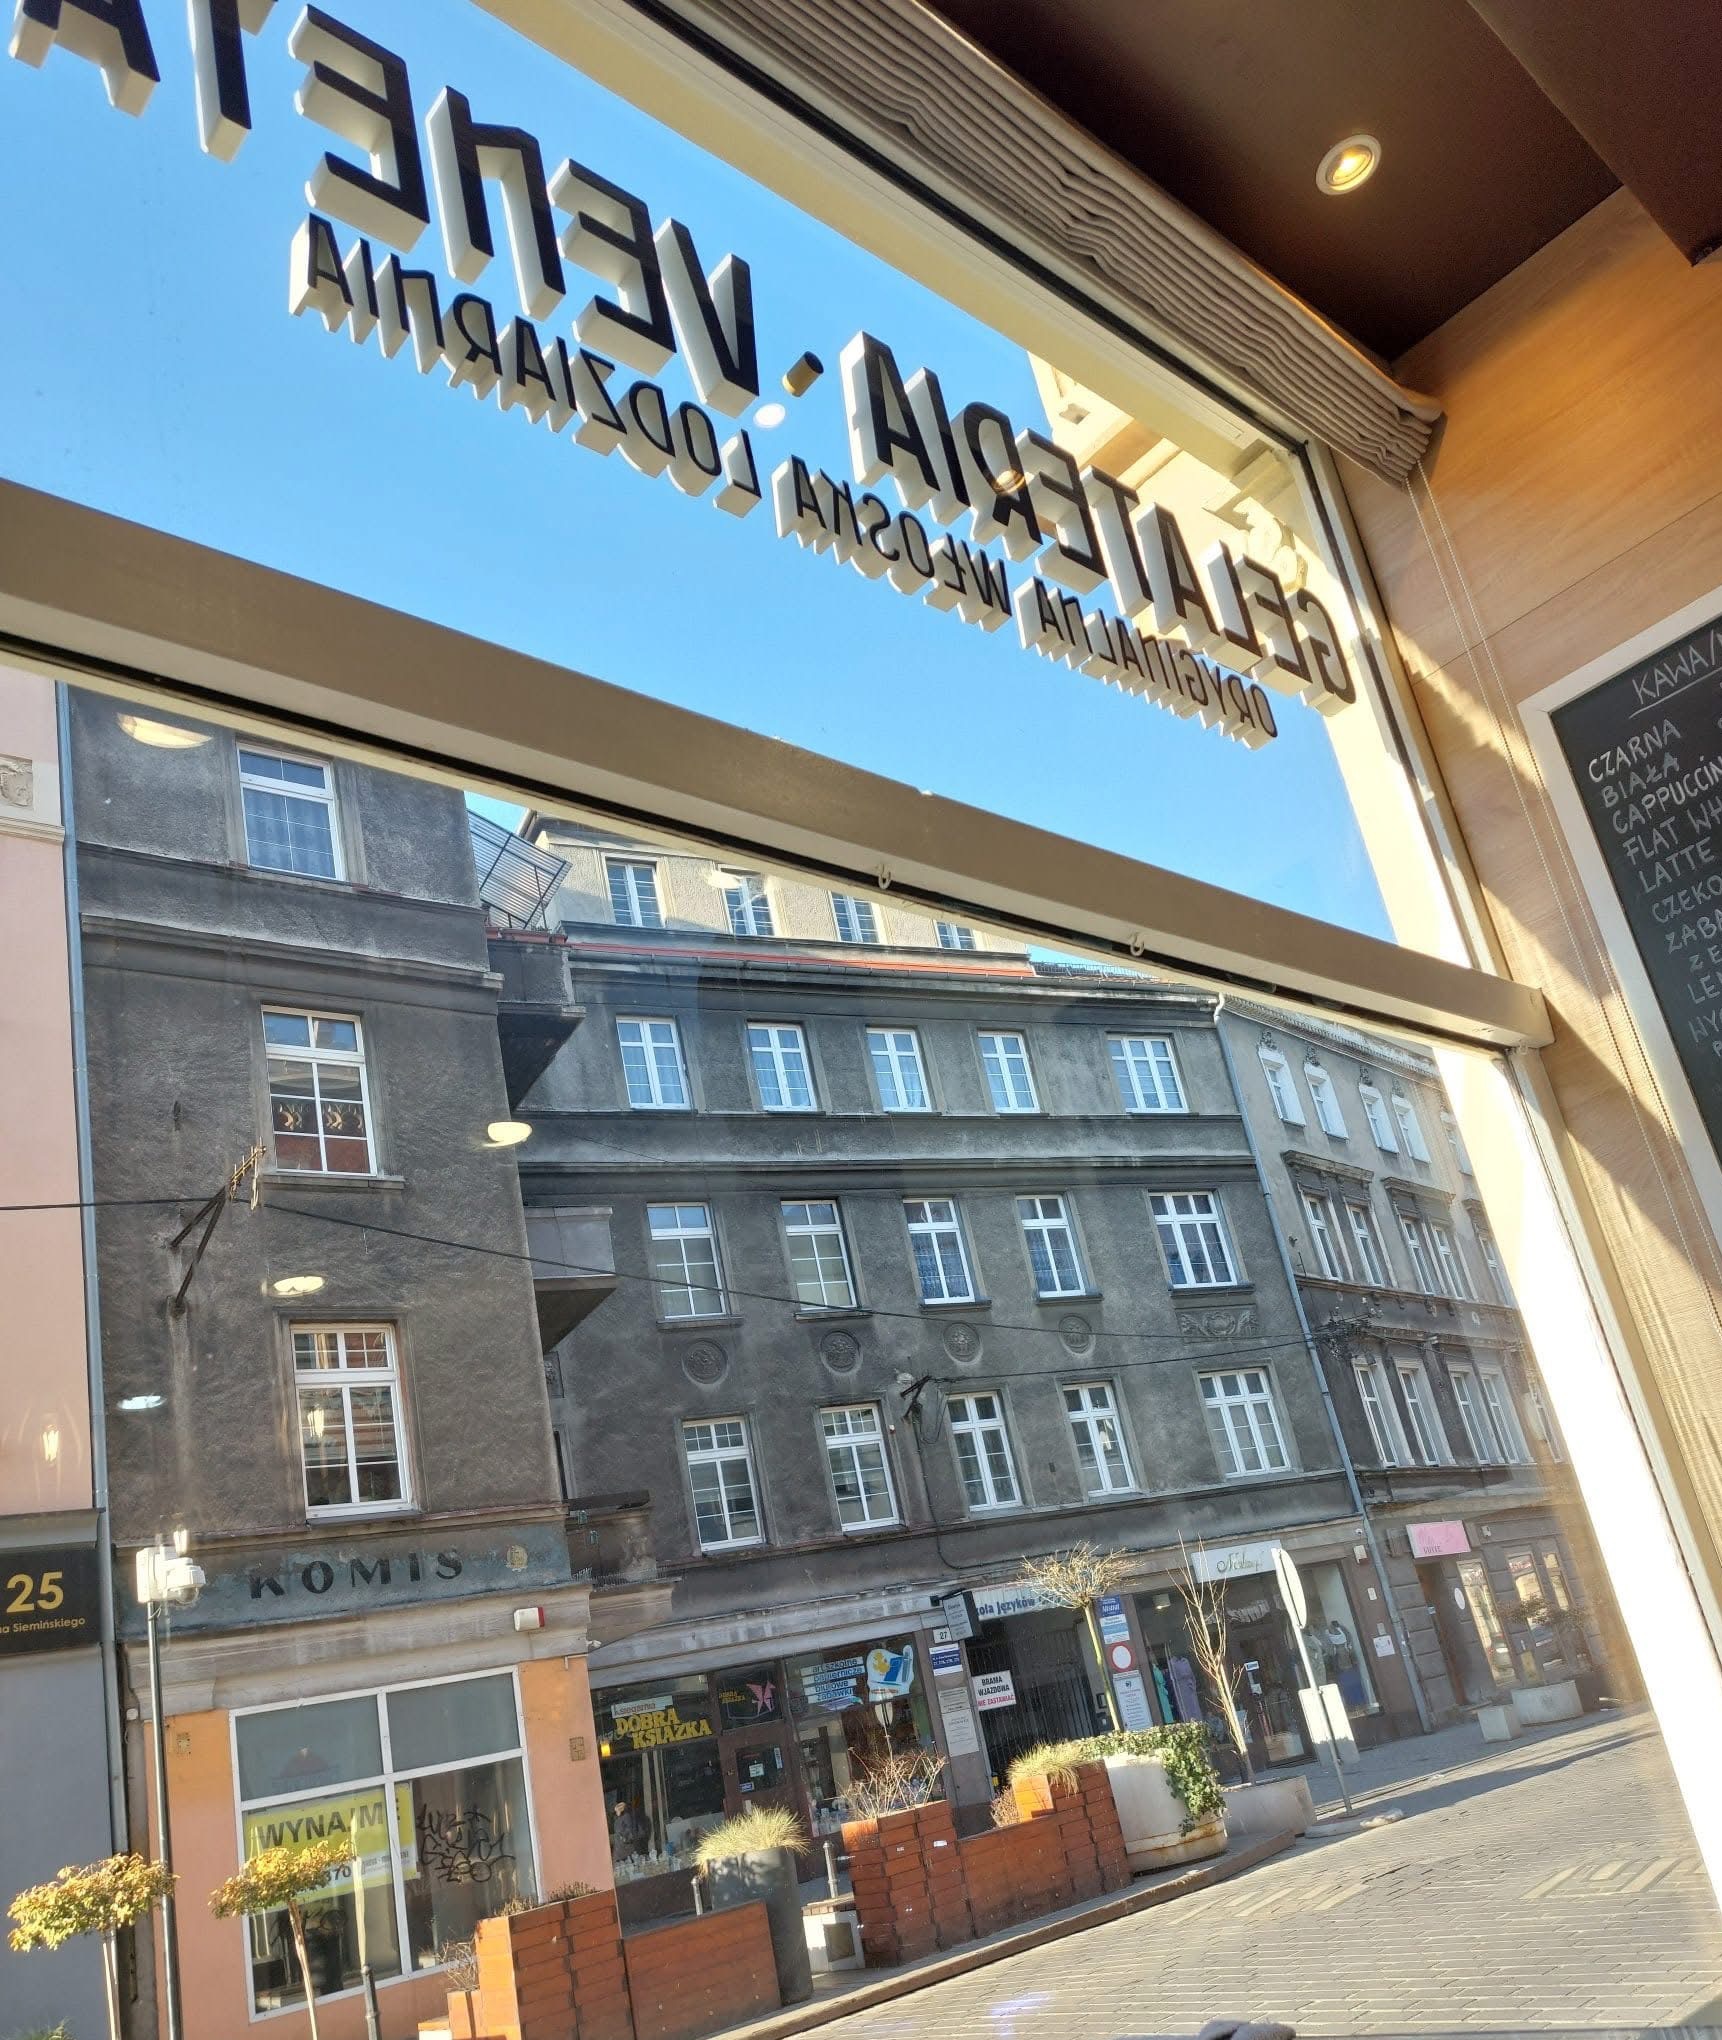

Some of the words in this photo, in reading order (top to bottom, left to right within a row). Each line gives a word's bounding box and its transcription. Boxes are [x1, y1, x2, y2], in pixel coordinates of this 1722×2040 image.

[1588, 719, 1681, 781] CZARNA
[1601, 752, 1679, 808] BIAŁA
[1623, 816, 1677, 865] FLAT
[1639, 836, 1714, 893] LATTE
[6, 1571, 64, 1613] 25
[250, 1549, 463, 1599] KOMIS
[13, 1617, 86, 1632] Siemińskiego
[940, 1631, 947, 1640] 27
[982, 1676, 1002, 1686] BRAMA
[615, 1707, 680, 1735] DOBRA
